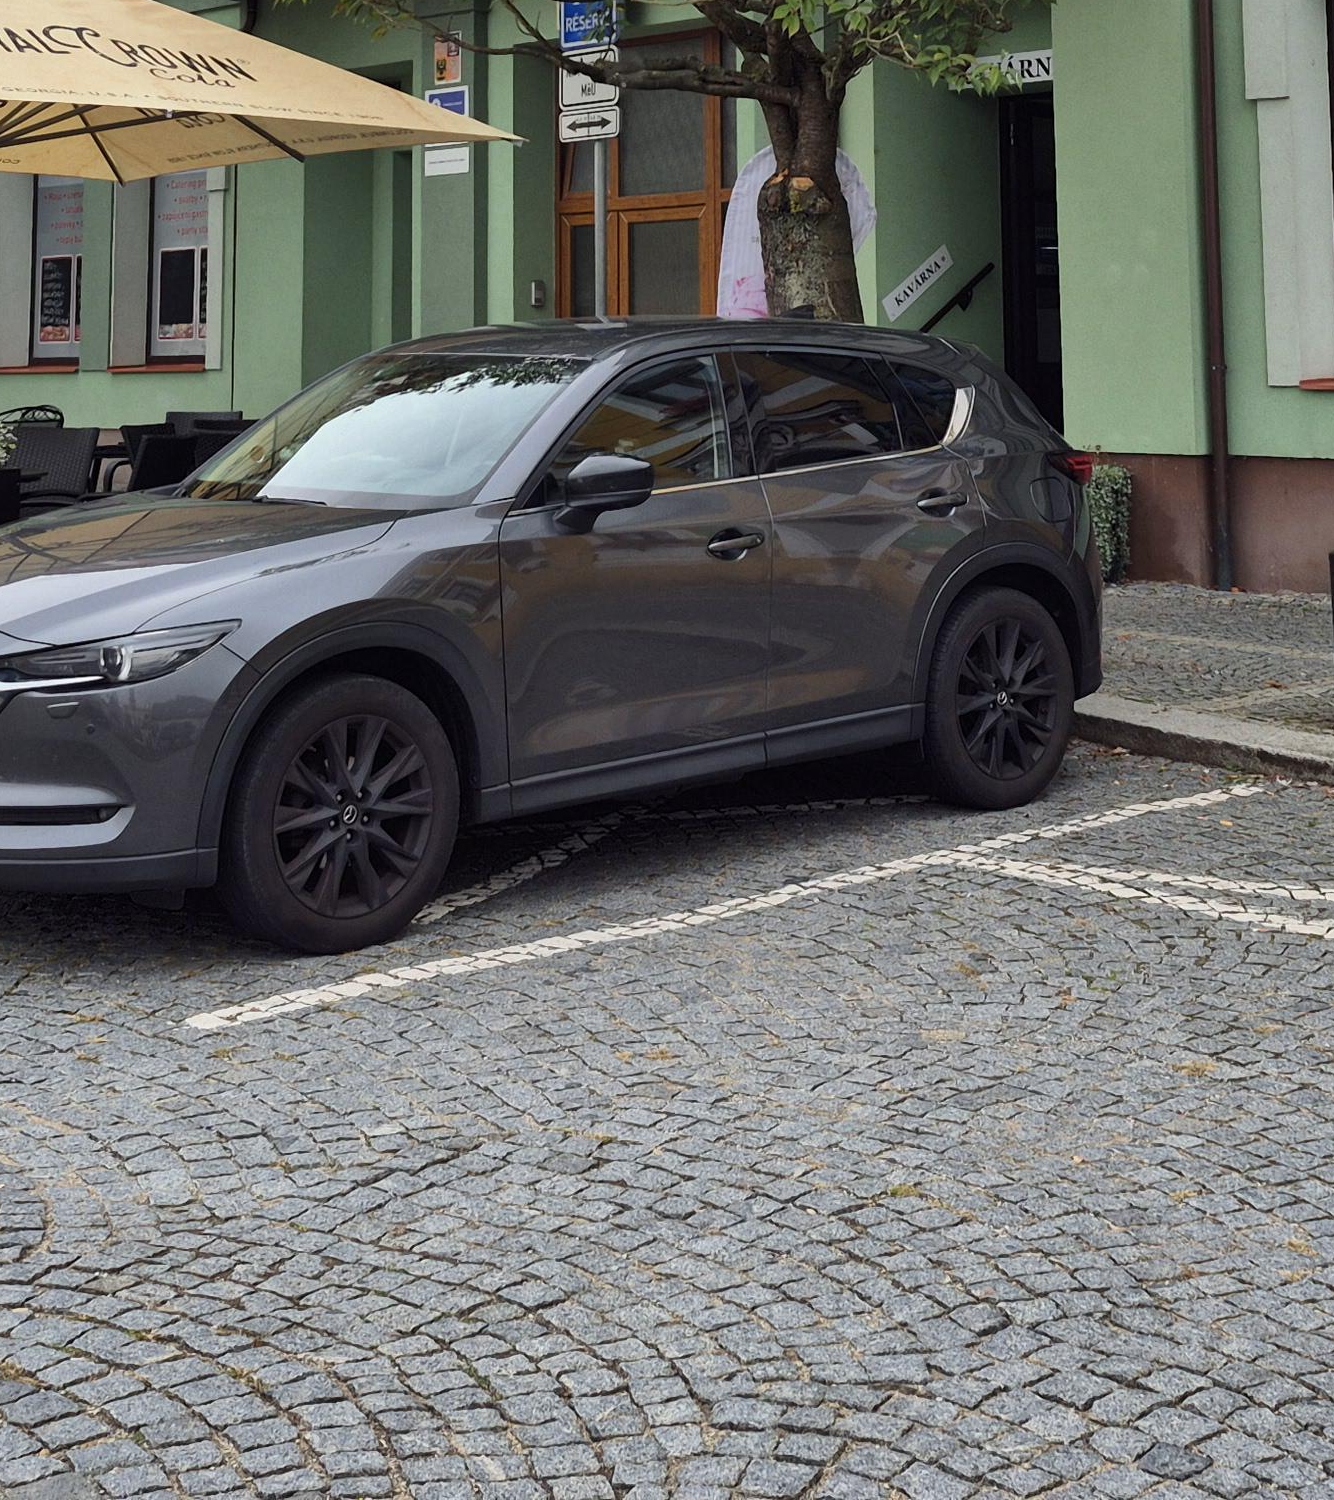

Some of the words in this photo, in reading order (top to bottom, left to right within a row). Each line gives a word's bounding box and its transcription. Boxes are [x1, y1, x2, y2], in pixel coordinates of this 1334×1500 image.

[42, 24, 258, 83] CROWN
[149, 67, 236, 89] Cola
[893, 259, 942, 307] KAVÁRNA
